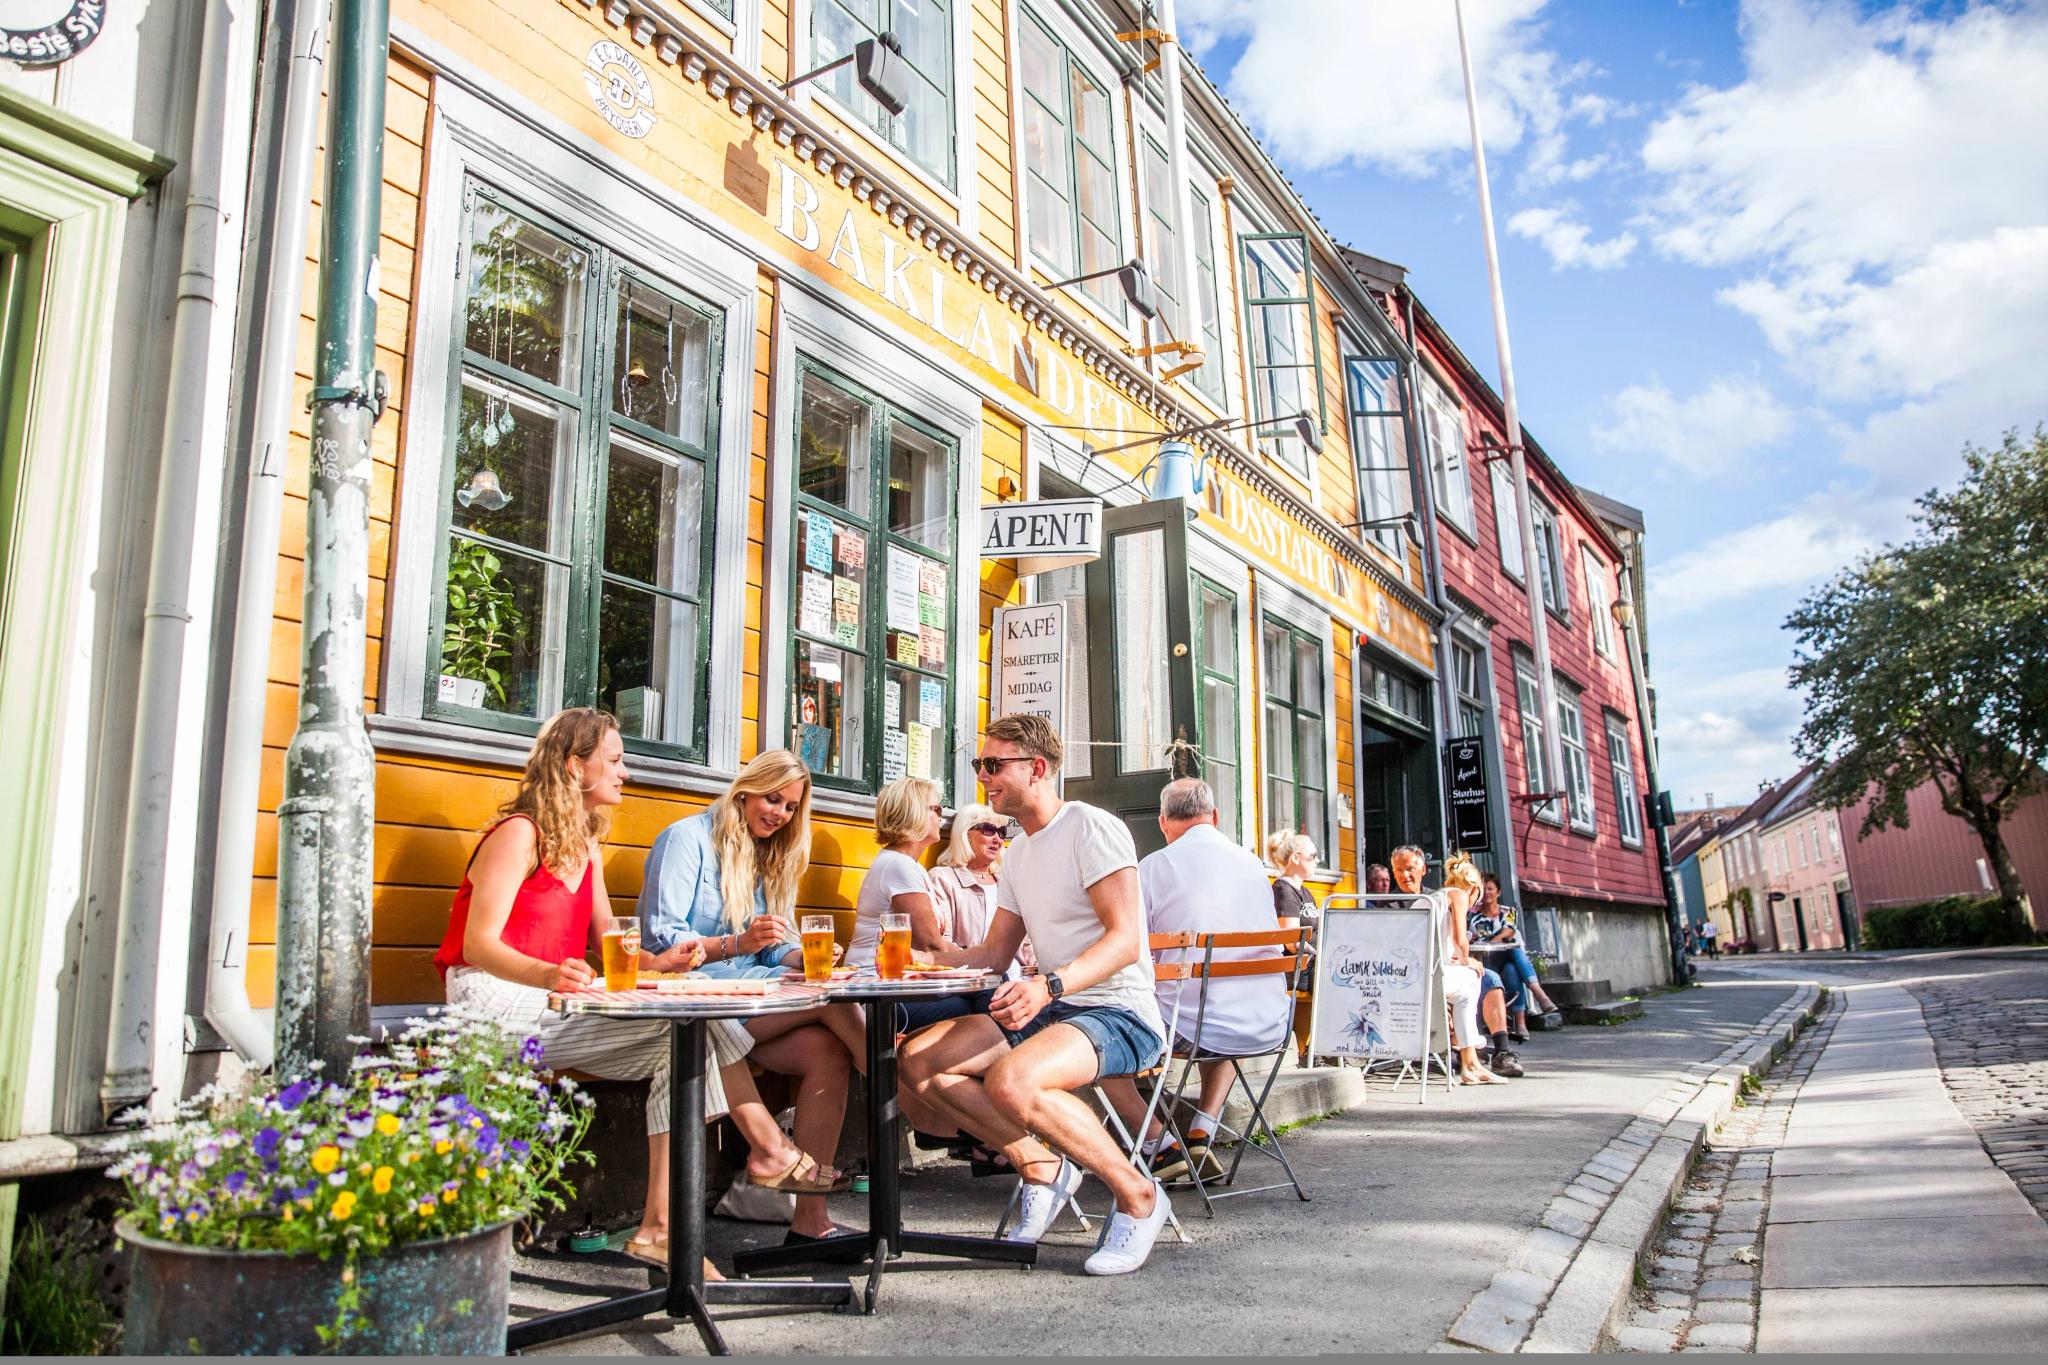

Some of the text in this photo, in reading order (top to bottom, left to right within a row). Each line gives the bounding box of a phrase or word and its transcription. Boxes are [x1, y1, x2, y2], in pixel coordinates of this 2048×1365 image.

[774, 157, 1356, 608] BAKLANDET YDSSTATION
[982, 510, 1093, 549] ÅPENT
[1007, 612, 1057, 640] KAFÉ
[1007, 680, 1053, 696] MIDDAG
